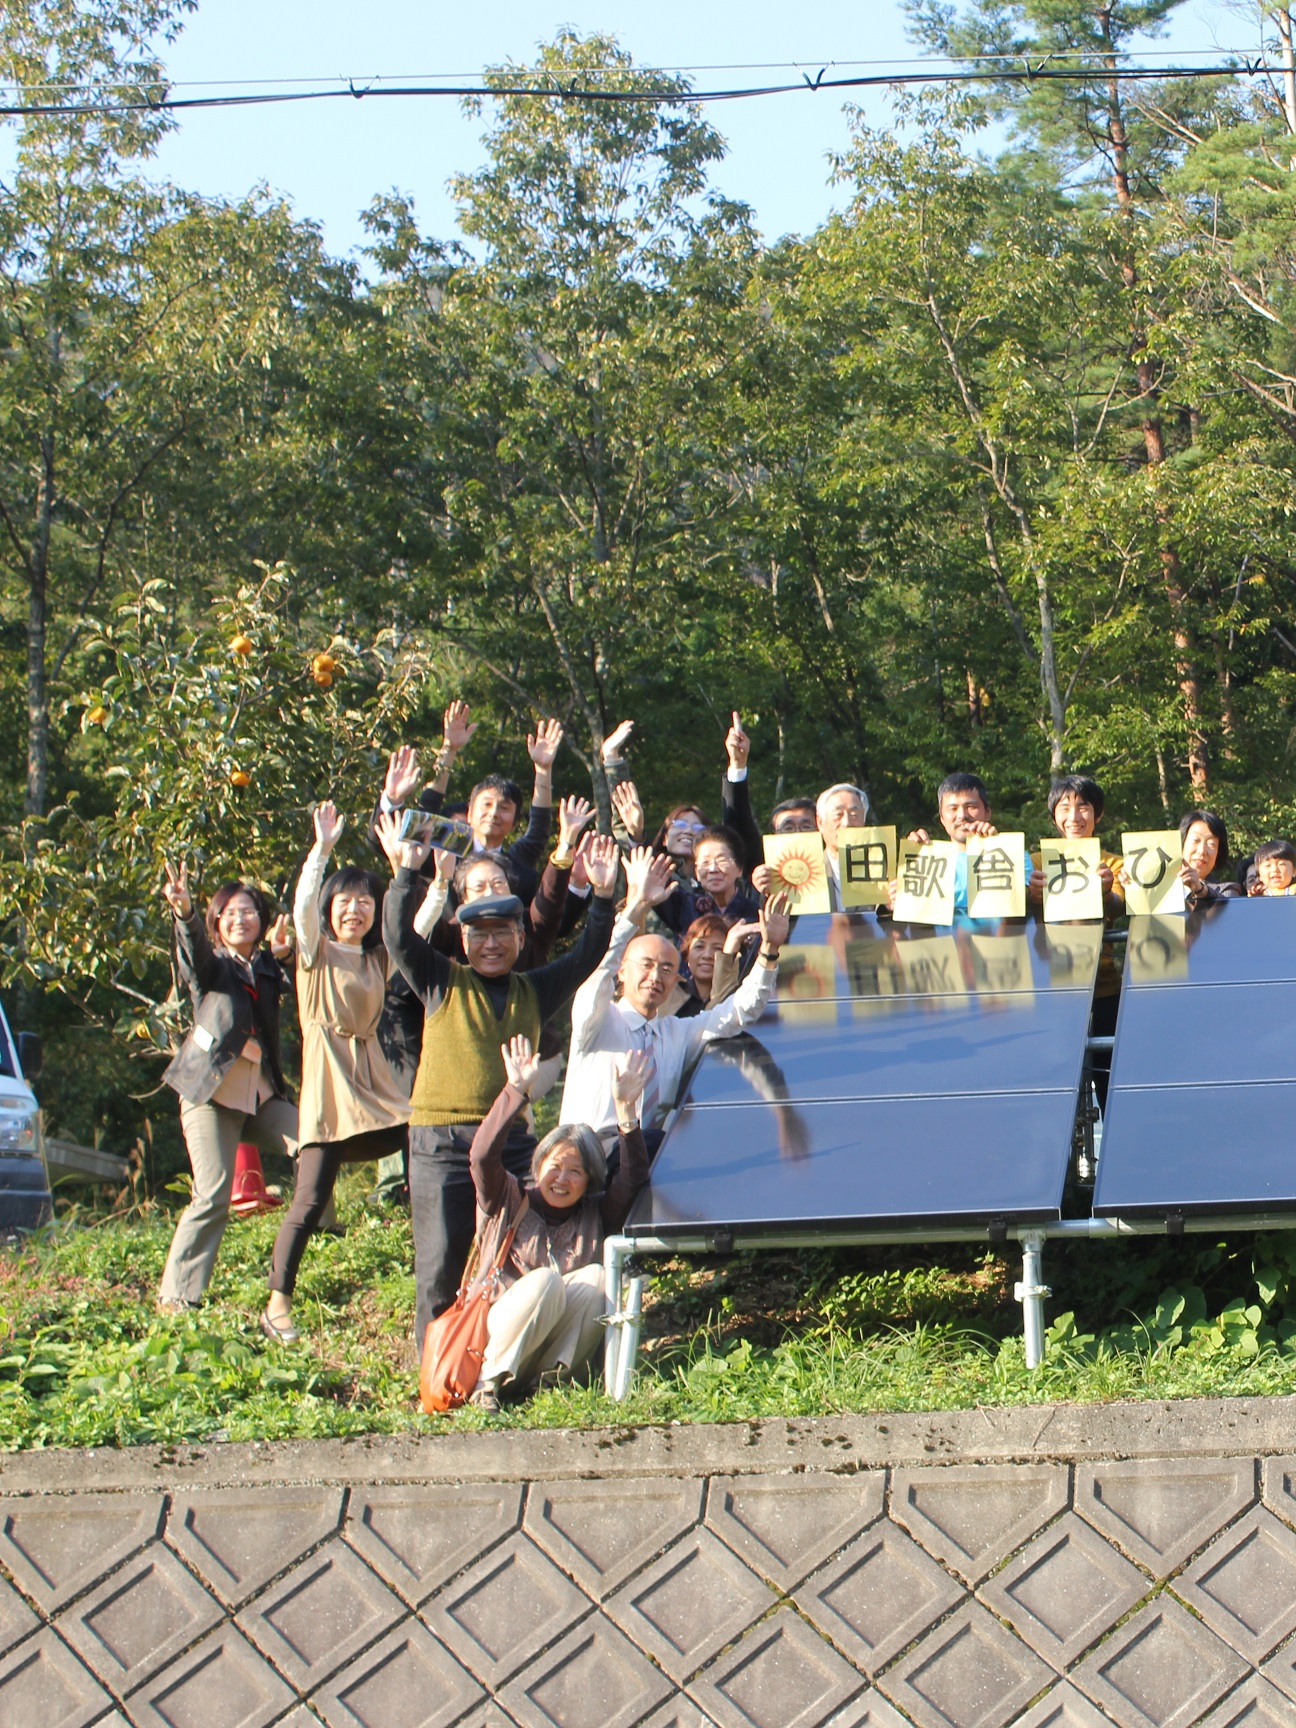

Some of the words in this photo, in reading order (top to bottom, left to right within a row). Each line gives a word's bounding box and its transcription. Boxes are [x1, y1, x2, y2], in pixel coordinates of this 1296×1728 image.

[845, 843, 889, 883] 田
[902, 852, 945, 900] 歌
[972, 847, 1014, 893] 舎
[1047, 852, 1091, 895] お
[1128, 846, 1173, 888] ひ
